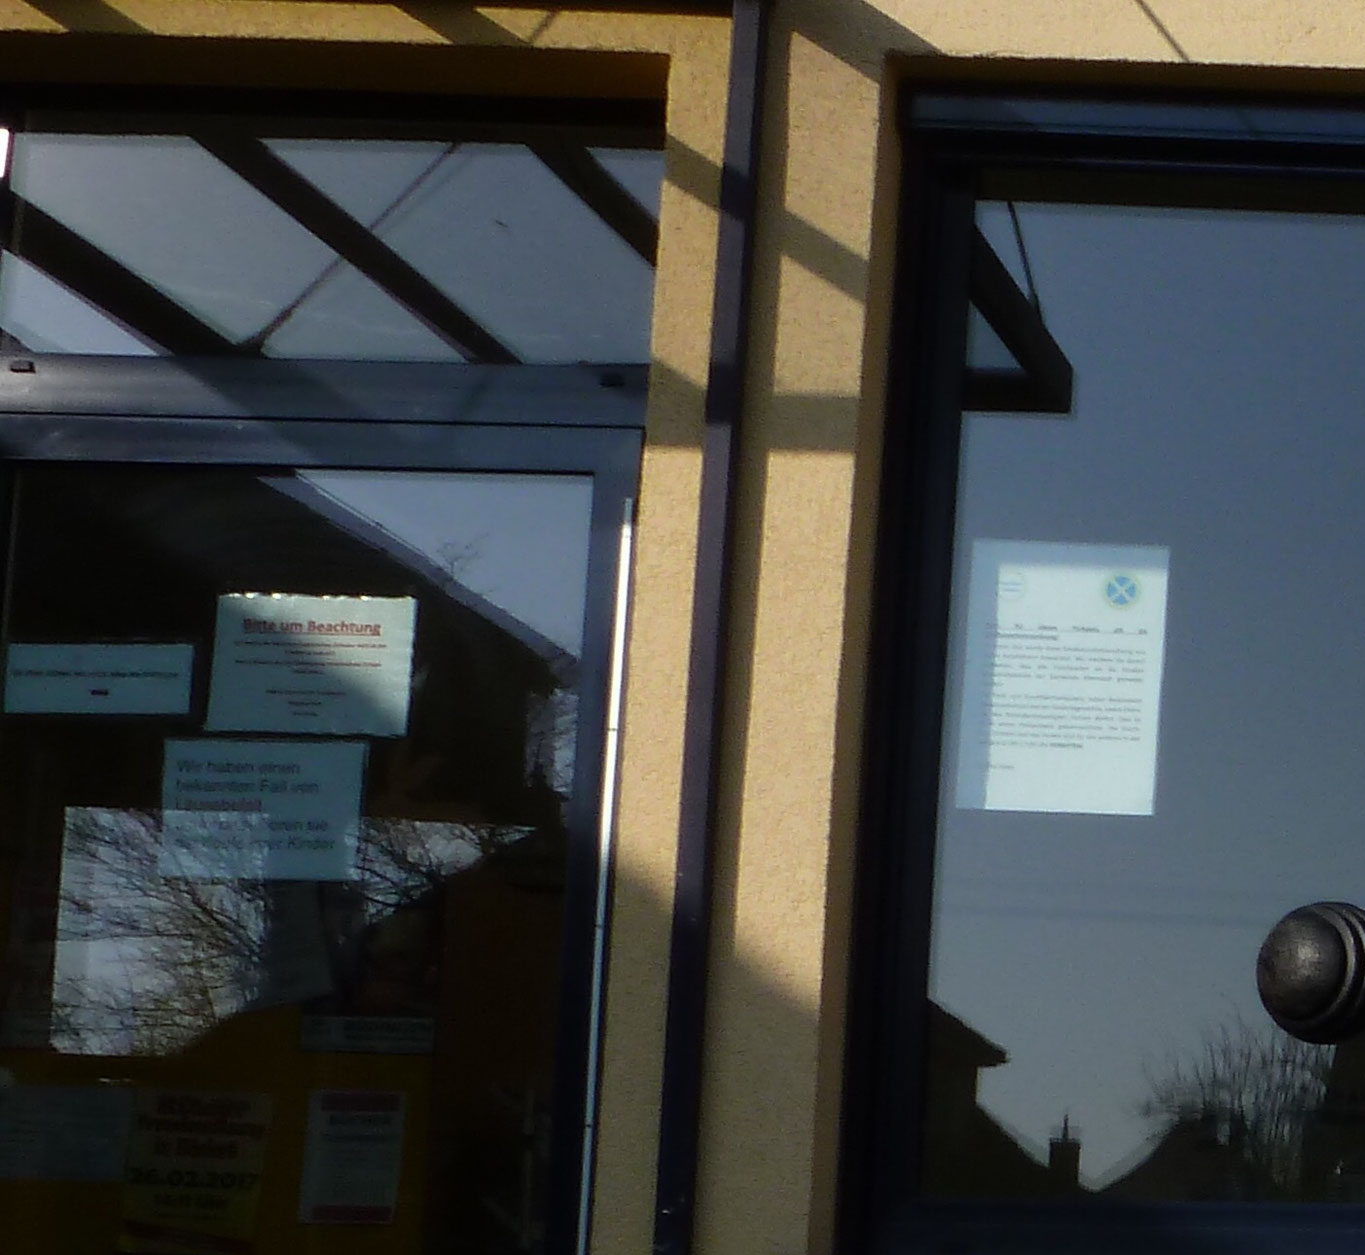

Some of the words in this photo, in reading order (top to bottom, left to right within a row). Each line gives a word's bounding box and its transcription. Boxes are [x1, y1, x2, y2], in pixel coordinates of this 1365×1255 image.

[243, 618, 275, 633] Bitte
[280, 622, 303, 633] um
[308, 620, 381, 635] Beachtung
[207, 759, 254, 773] haben
